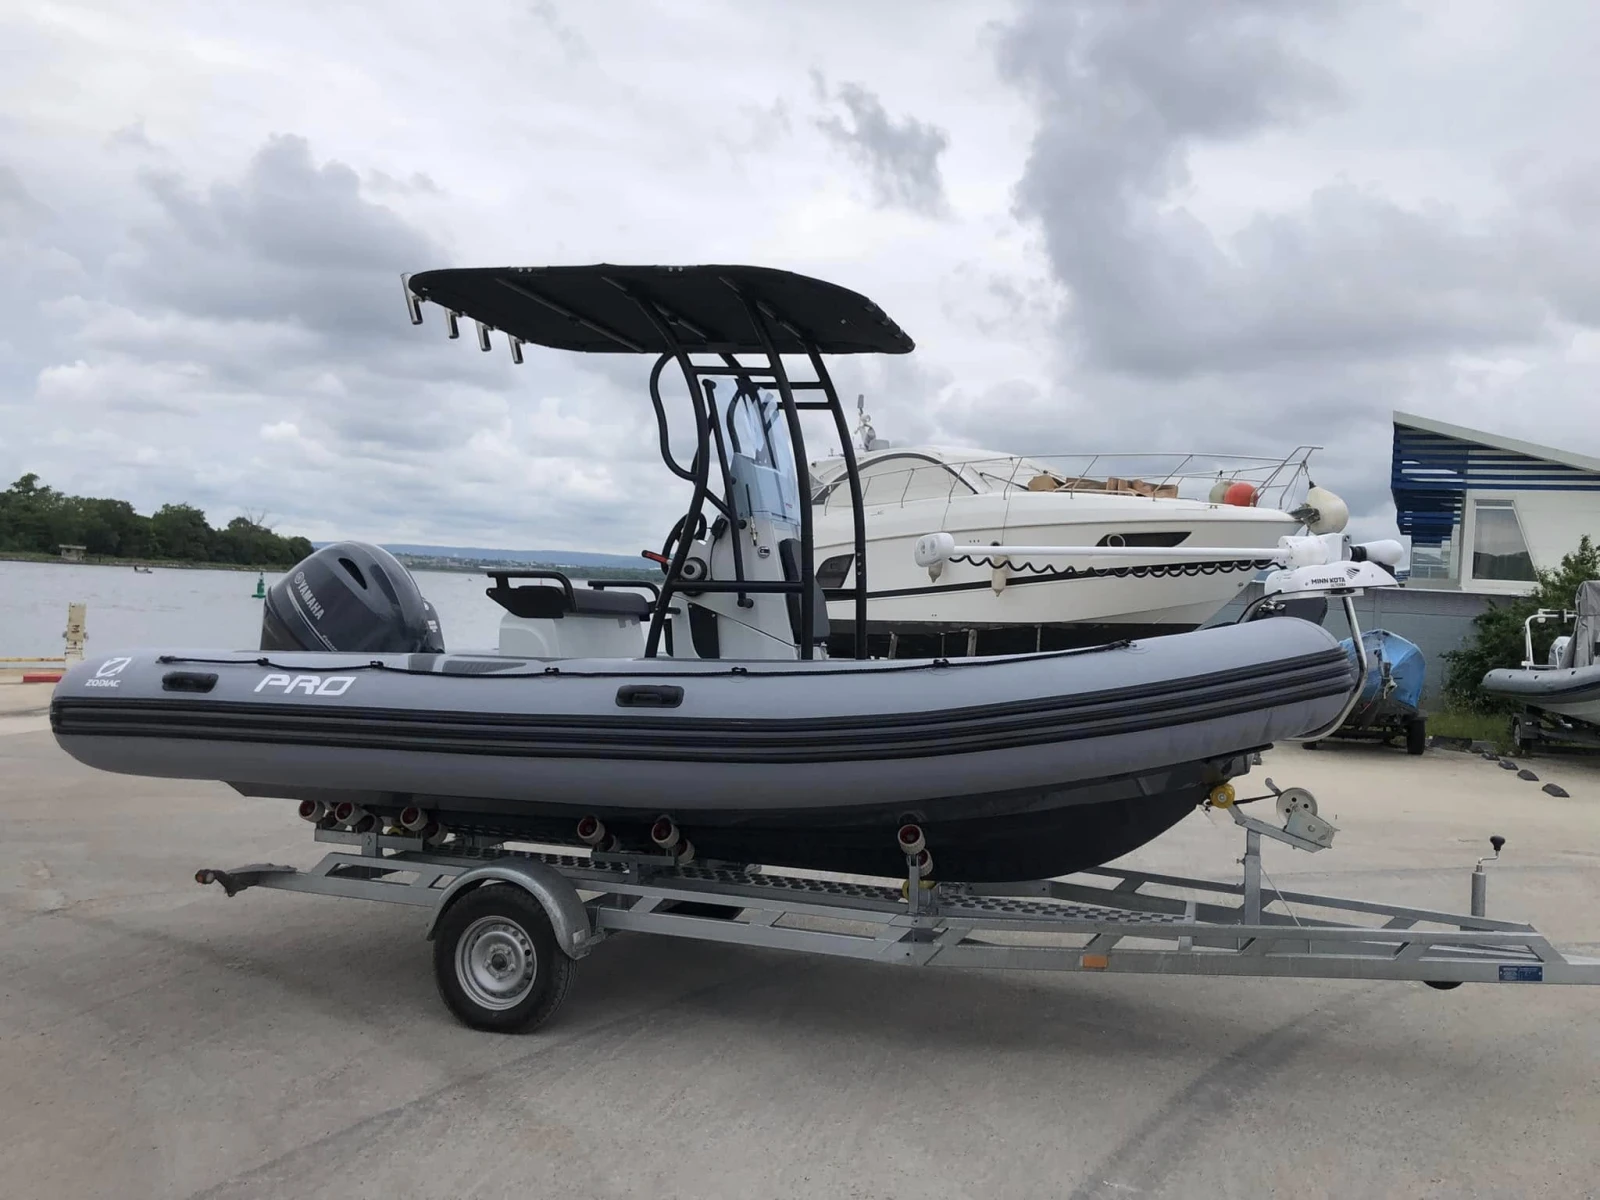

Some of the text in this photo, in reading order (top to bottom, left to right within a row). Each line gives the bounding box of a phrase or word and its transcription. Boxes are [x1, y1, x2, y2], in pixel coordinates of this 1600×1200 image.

[1311, 577, 1329, 585] MINN
[298, 579, 325, 620] YAMAHA
[85, 679, 121, 688] ZODIAC
[254, 674, 357, 696] PRO
